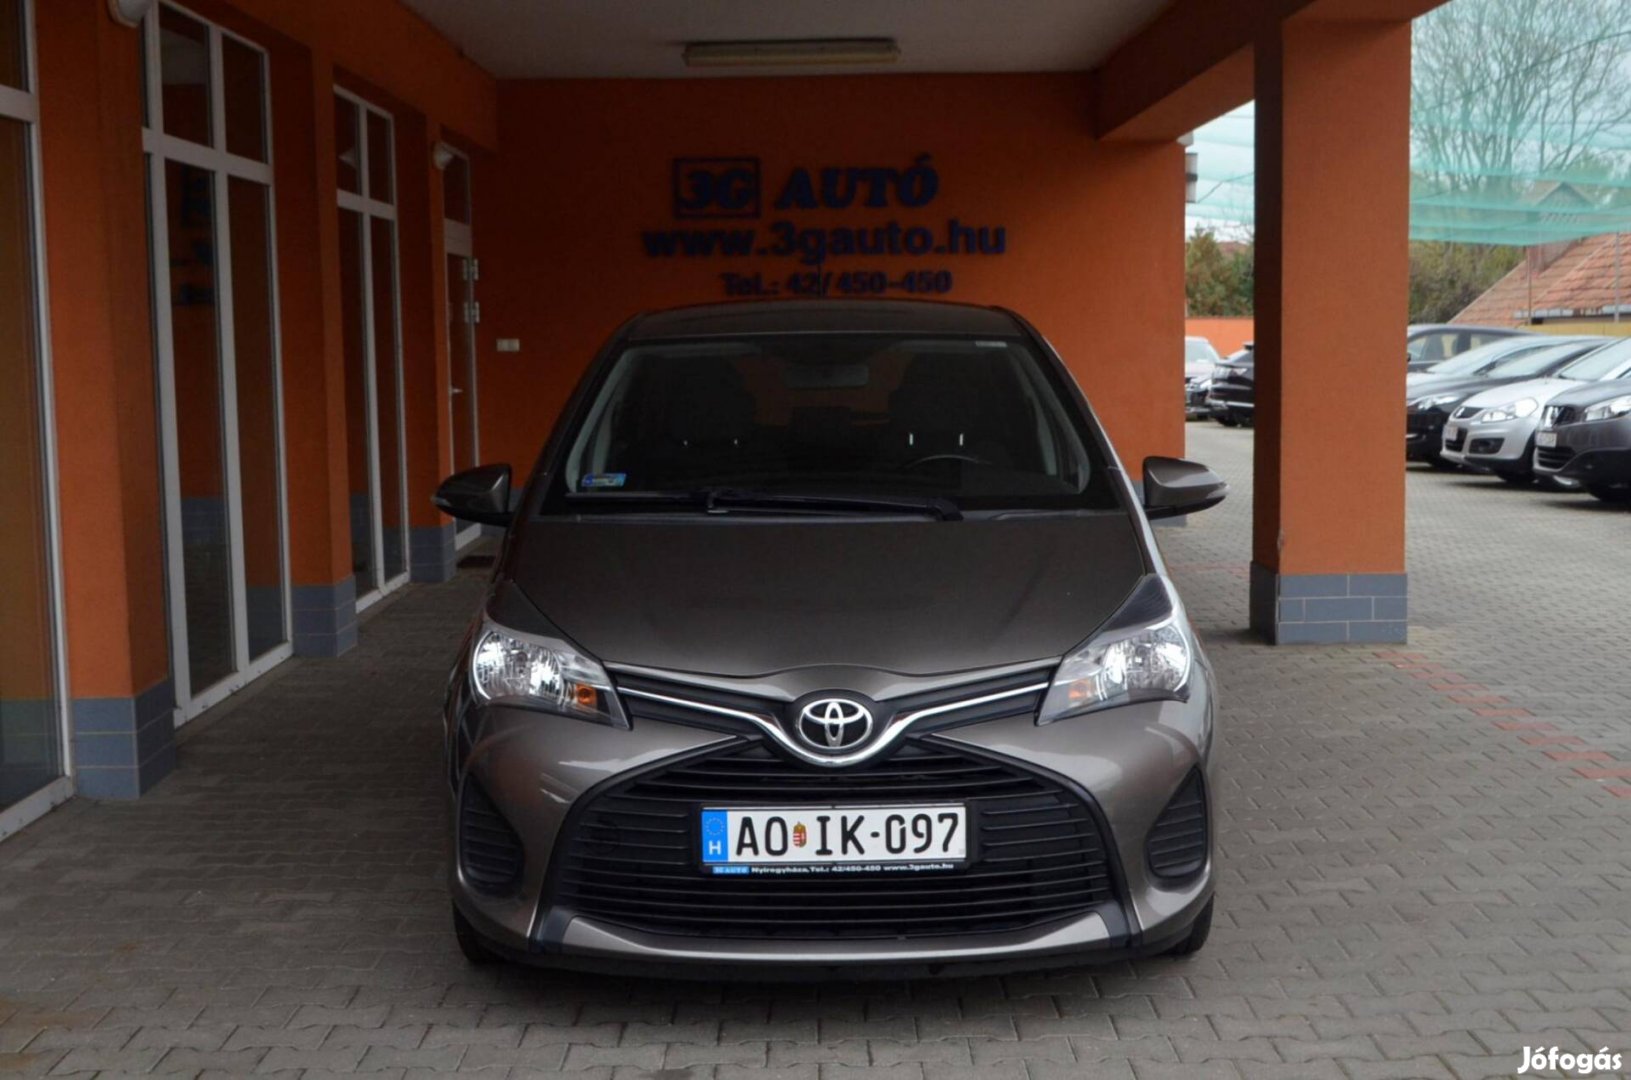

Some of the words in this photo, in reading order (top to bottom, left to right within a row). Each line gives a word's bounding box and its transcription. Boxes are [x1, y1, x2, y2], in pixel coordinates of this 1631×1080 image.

[678, 168, 754, 209] 3G
[775, 153, 938, 208] AUTÓ
[642, 219, 1004, 265] www.3gauto.hu
[708, 840, 721, 855] H
[736, 816, 788, 856] AO
[883, 862, 954, 871] www.3gauto.hu
